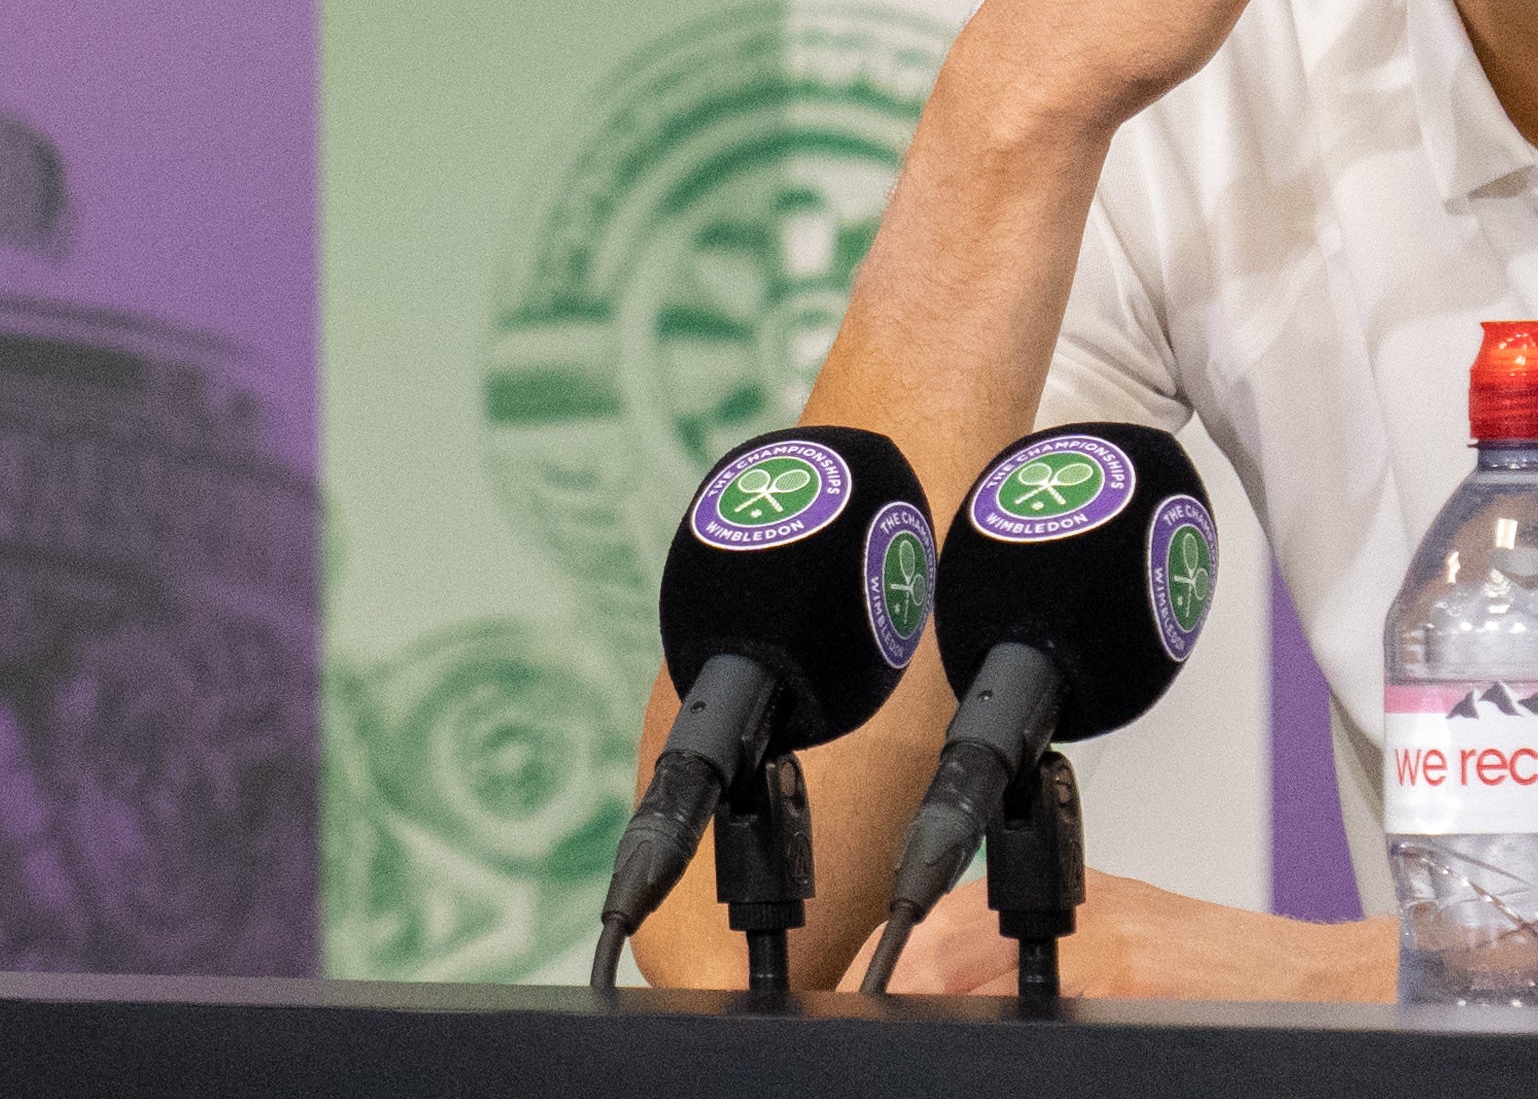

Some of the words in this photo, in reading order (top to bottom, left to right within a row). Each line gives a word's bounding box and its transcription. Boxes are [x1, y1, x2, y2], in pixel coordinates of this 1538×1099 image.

[708, 470, 735, 498] THE
[735, 445, 842, 496] CHAMPIONSHIPS
[986, 464, 1015, 489] THE
[1015, 440, 1126, 490] CHAMPIONSHIPS
[880, 512, 902, 536] THE
[985, 511, 1089, 534] WIMBLEDON
[1162, 504, 1185, 527] THE
[705, 519, 805, 543] WIMBLEDON
[1395, 747, 1447, 786] we
